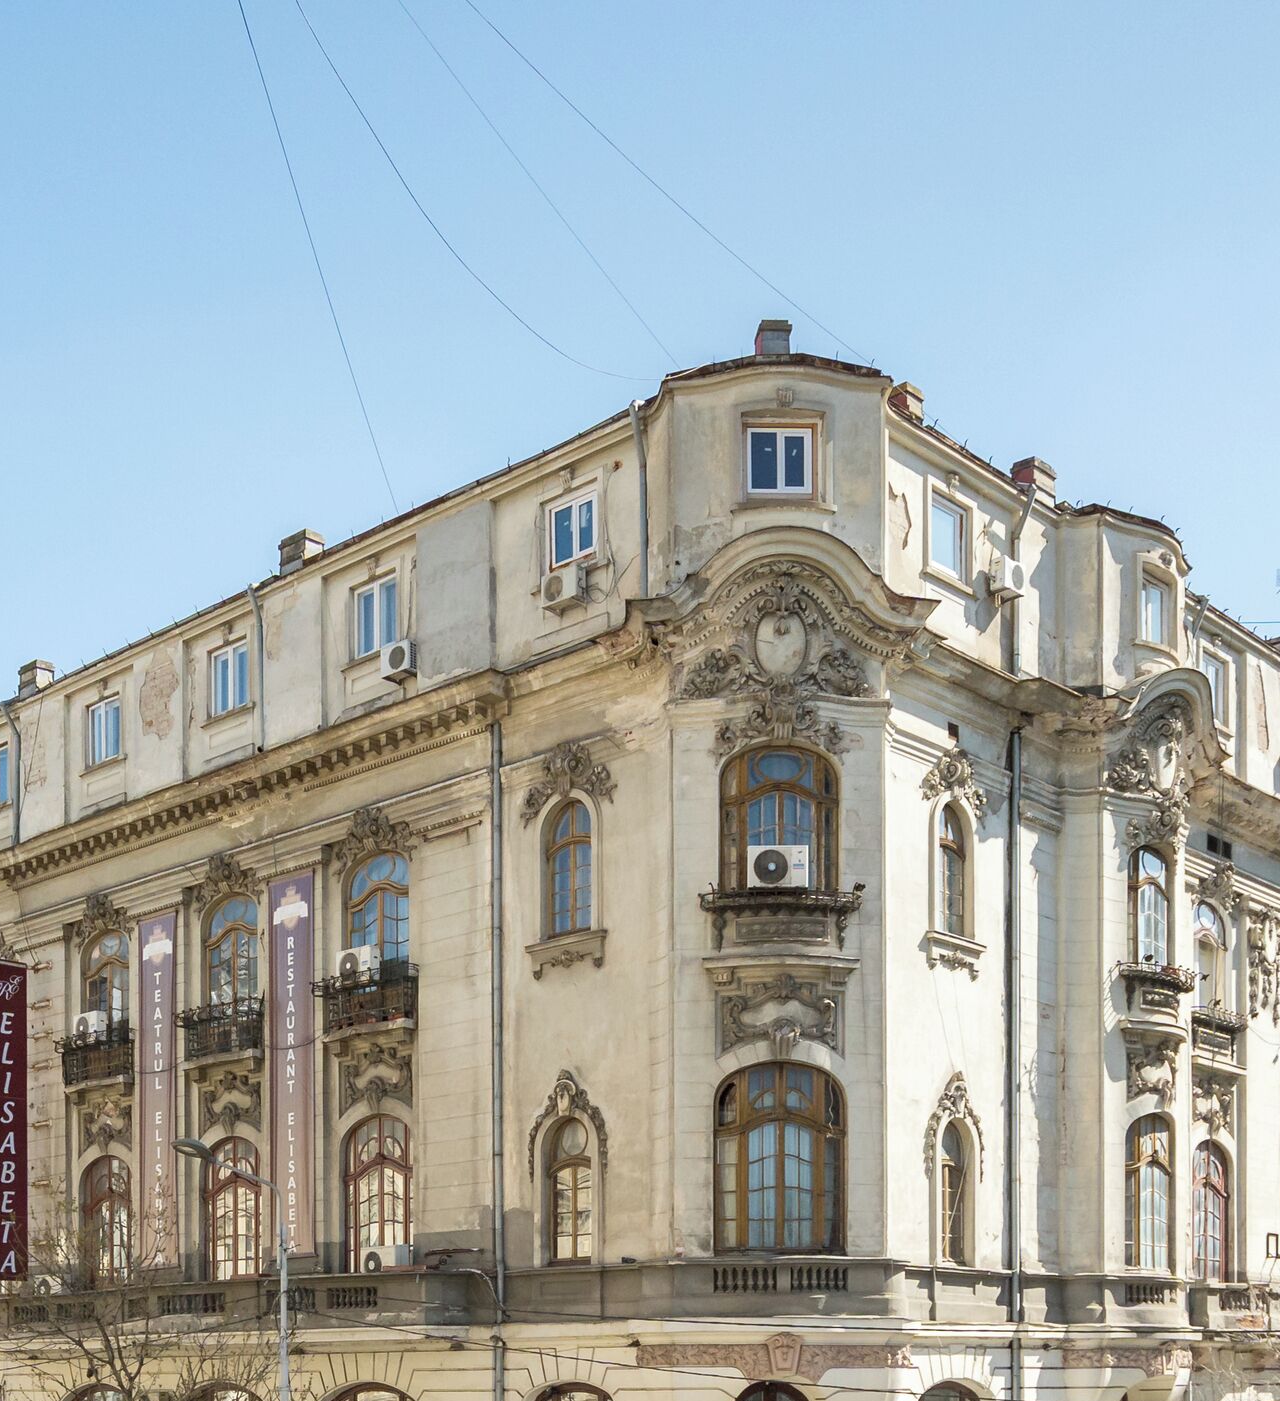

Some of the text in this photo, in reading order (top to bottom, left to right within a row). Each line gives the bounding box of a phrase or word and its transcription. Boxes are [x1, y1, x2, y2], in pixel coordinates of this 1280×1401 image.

[0, 1011, 17, 1274] ELISABETA
[153, 972, 163, 1090] TEATRUL
[286, 936, 297, 1254] RESTAURANT ELISABETA
